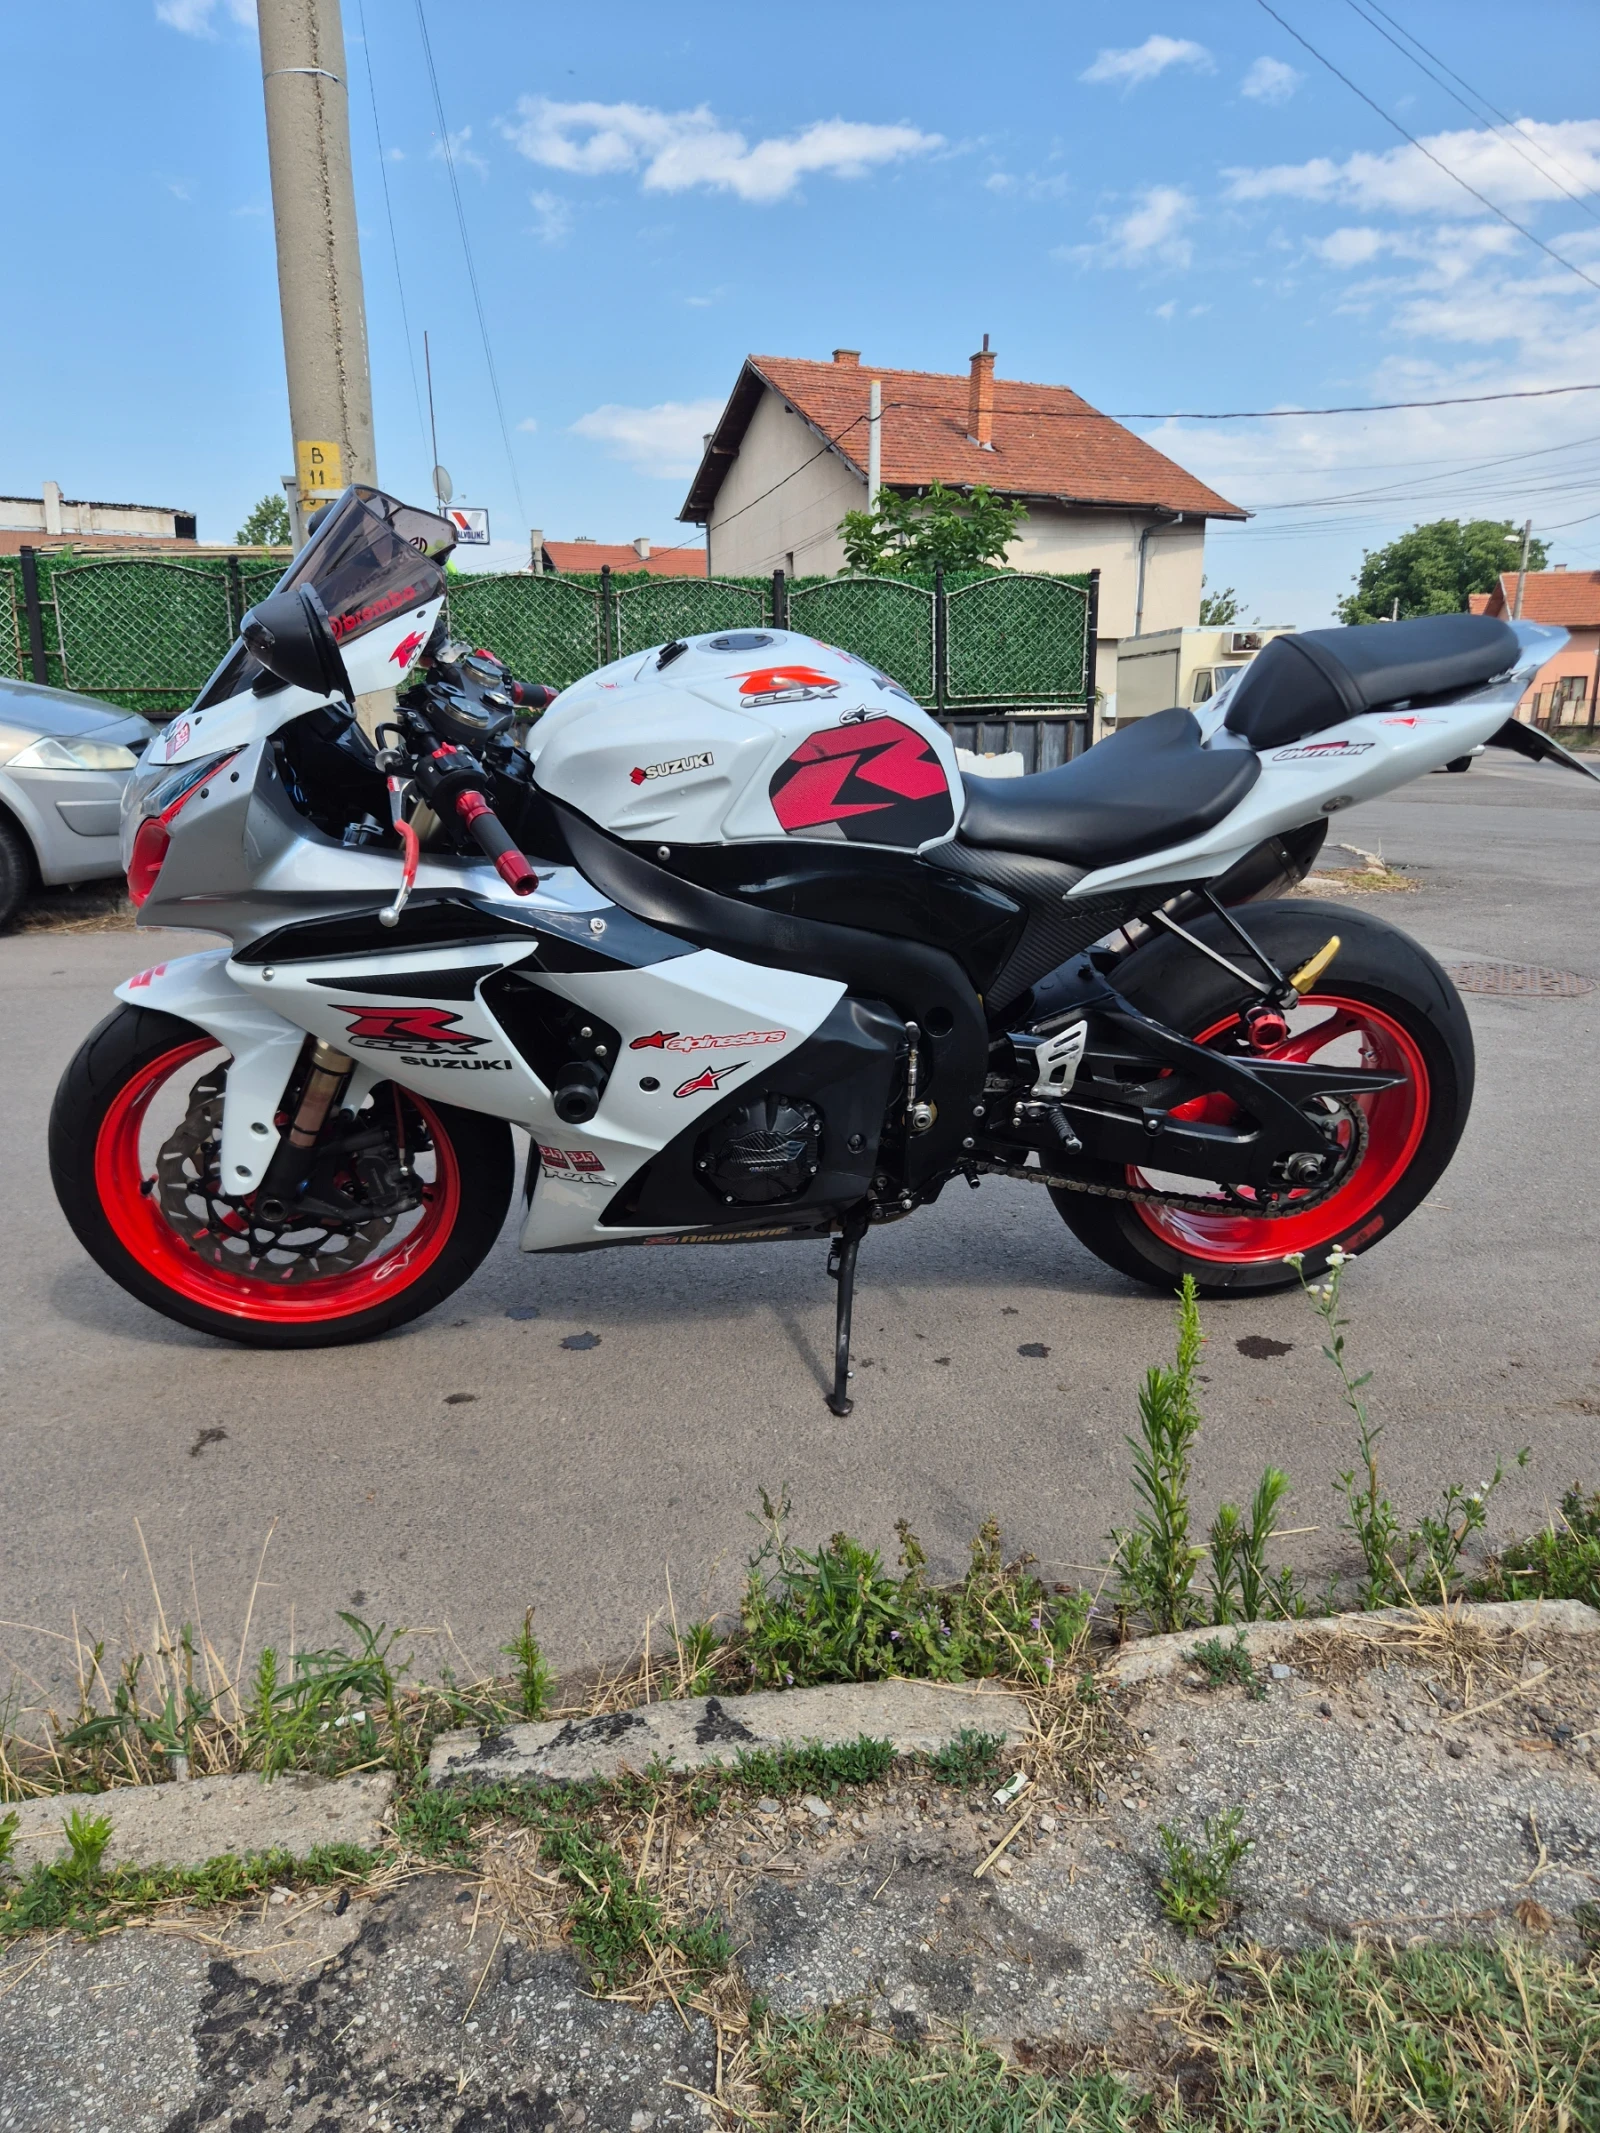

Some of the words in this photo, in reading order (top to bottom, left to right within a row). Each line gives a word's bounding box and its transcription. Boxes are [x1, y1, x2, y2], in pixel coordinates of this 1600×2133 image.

[310, 470, 325, 485] 11
[456, 530, 485, 540] ALVOLINE
[342, 585, 416, 632] brembo
[645, 751, 714, 780] SUZUKI
[348, 1035, 478, 1055] GSX
[666, 1030, 787, 1053] alpinestars
[400, 1055, 513, 1071] SUZUKI
